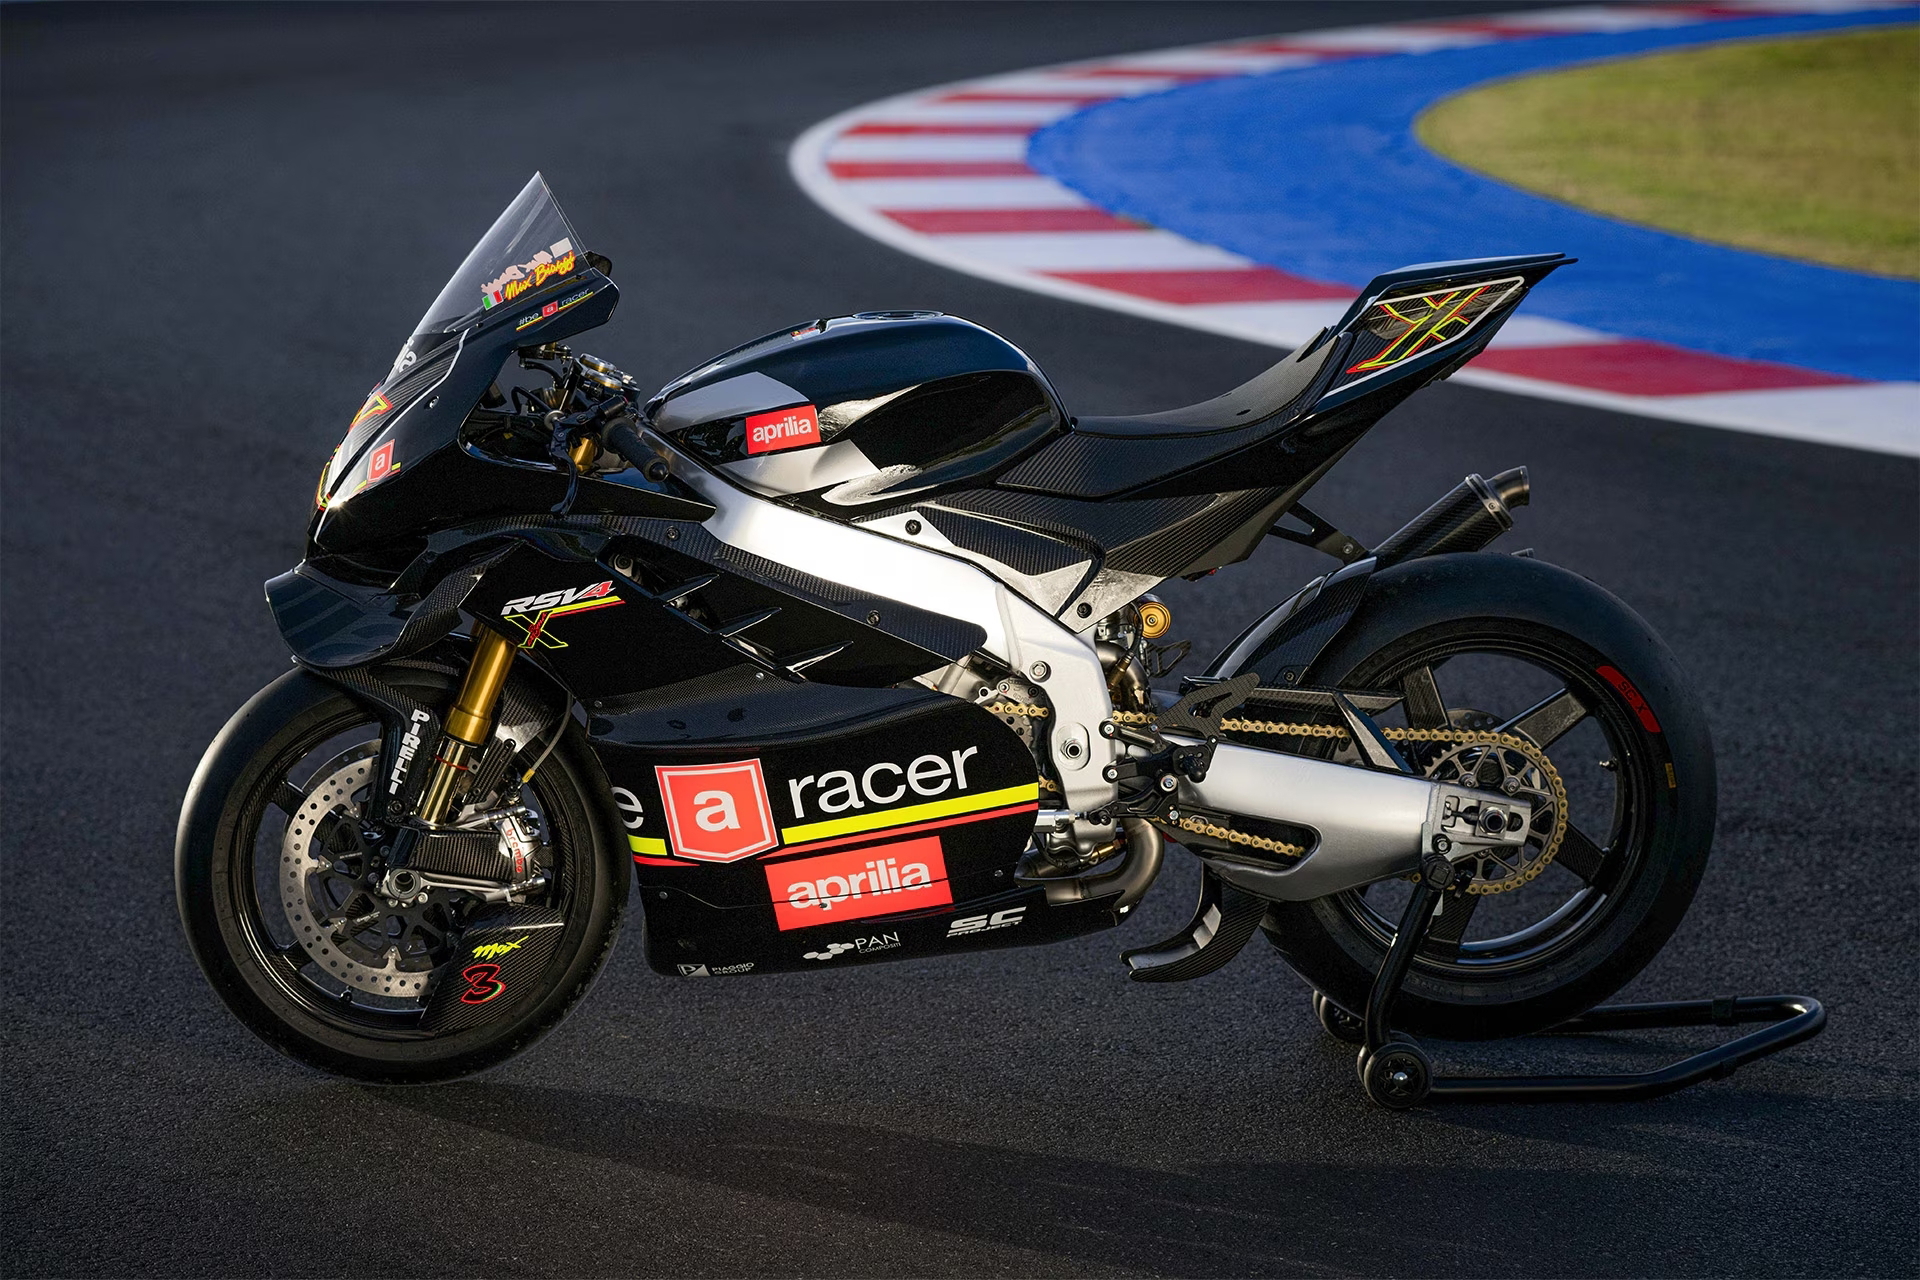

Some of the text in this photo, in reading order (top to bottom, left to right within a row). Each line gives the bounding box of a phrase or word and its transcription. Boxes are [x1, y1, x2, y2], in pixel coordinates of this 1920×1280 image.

[561, 288, 590, 306] racer
[753, 416, 812, 444] aprilia
[374, 452, 386, 471] a
[500, 580, 616, 615] RSV4
[389, 708, 430, 795] PIRELLI
[693, 789, 741, 832] a
[788, 745, 978, 818] racer
[505, 828, 525, 874] brembo
[787, 857, 933, 911] aprilia
[948, 906, 1027, 933] SC
[855, 931, 900, 950] PAN
[460, 963, 506, 1004] 3
